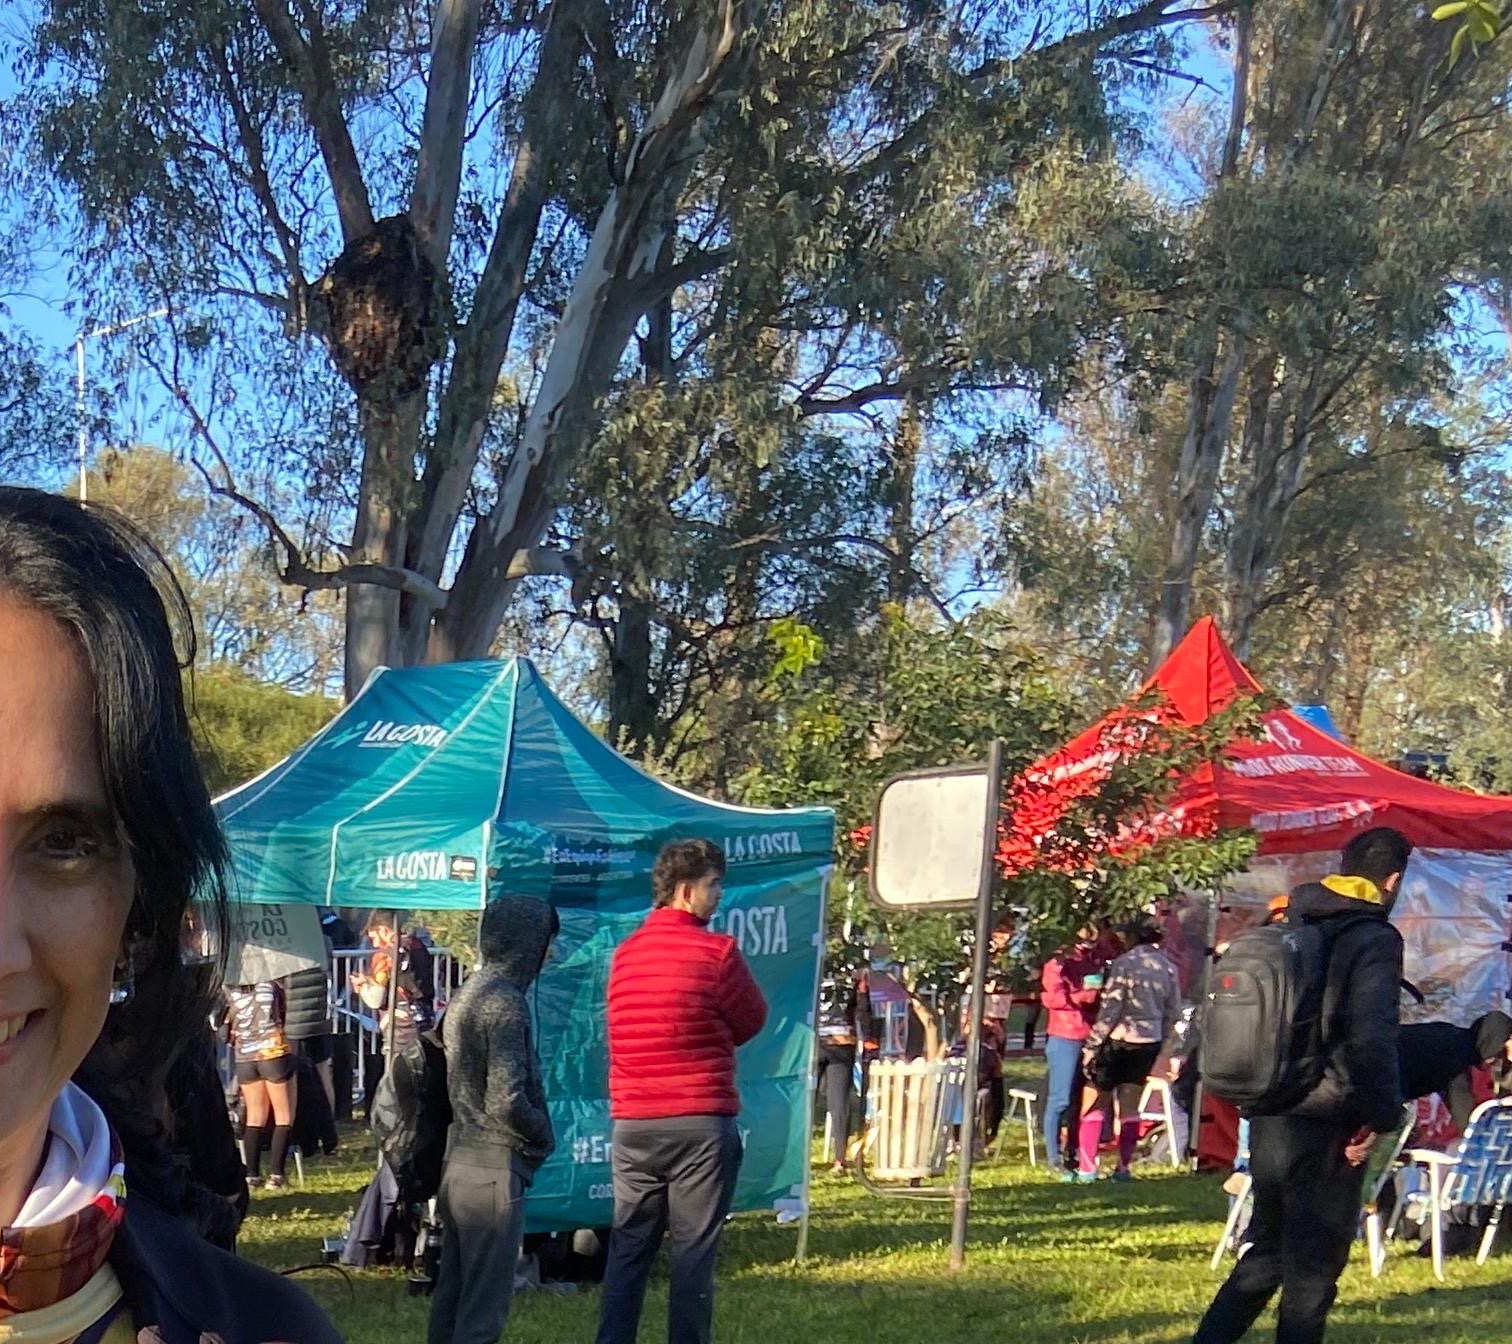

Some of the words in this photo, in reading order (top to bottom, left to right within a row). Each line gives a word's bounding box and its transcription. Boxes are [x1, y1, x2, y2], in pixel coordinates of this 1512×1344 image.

[363, 720, 394, 741] LA
[1320, 757, 1364, 772] TEAM
[724, 836, 745, 863] LA
[748, 832, 802, 860] COSTA
[376, 856, 394, 880] LA
